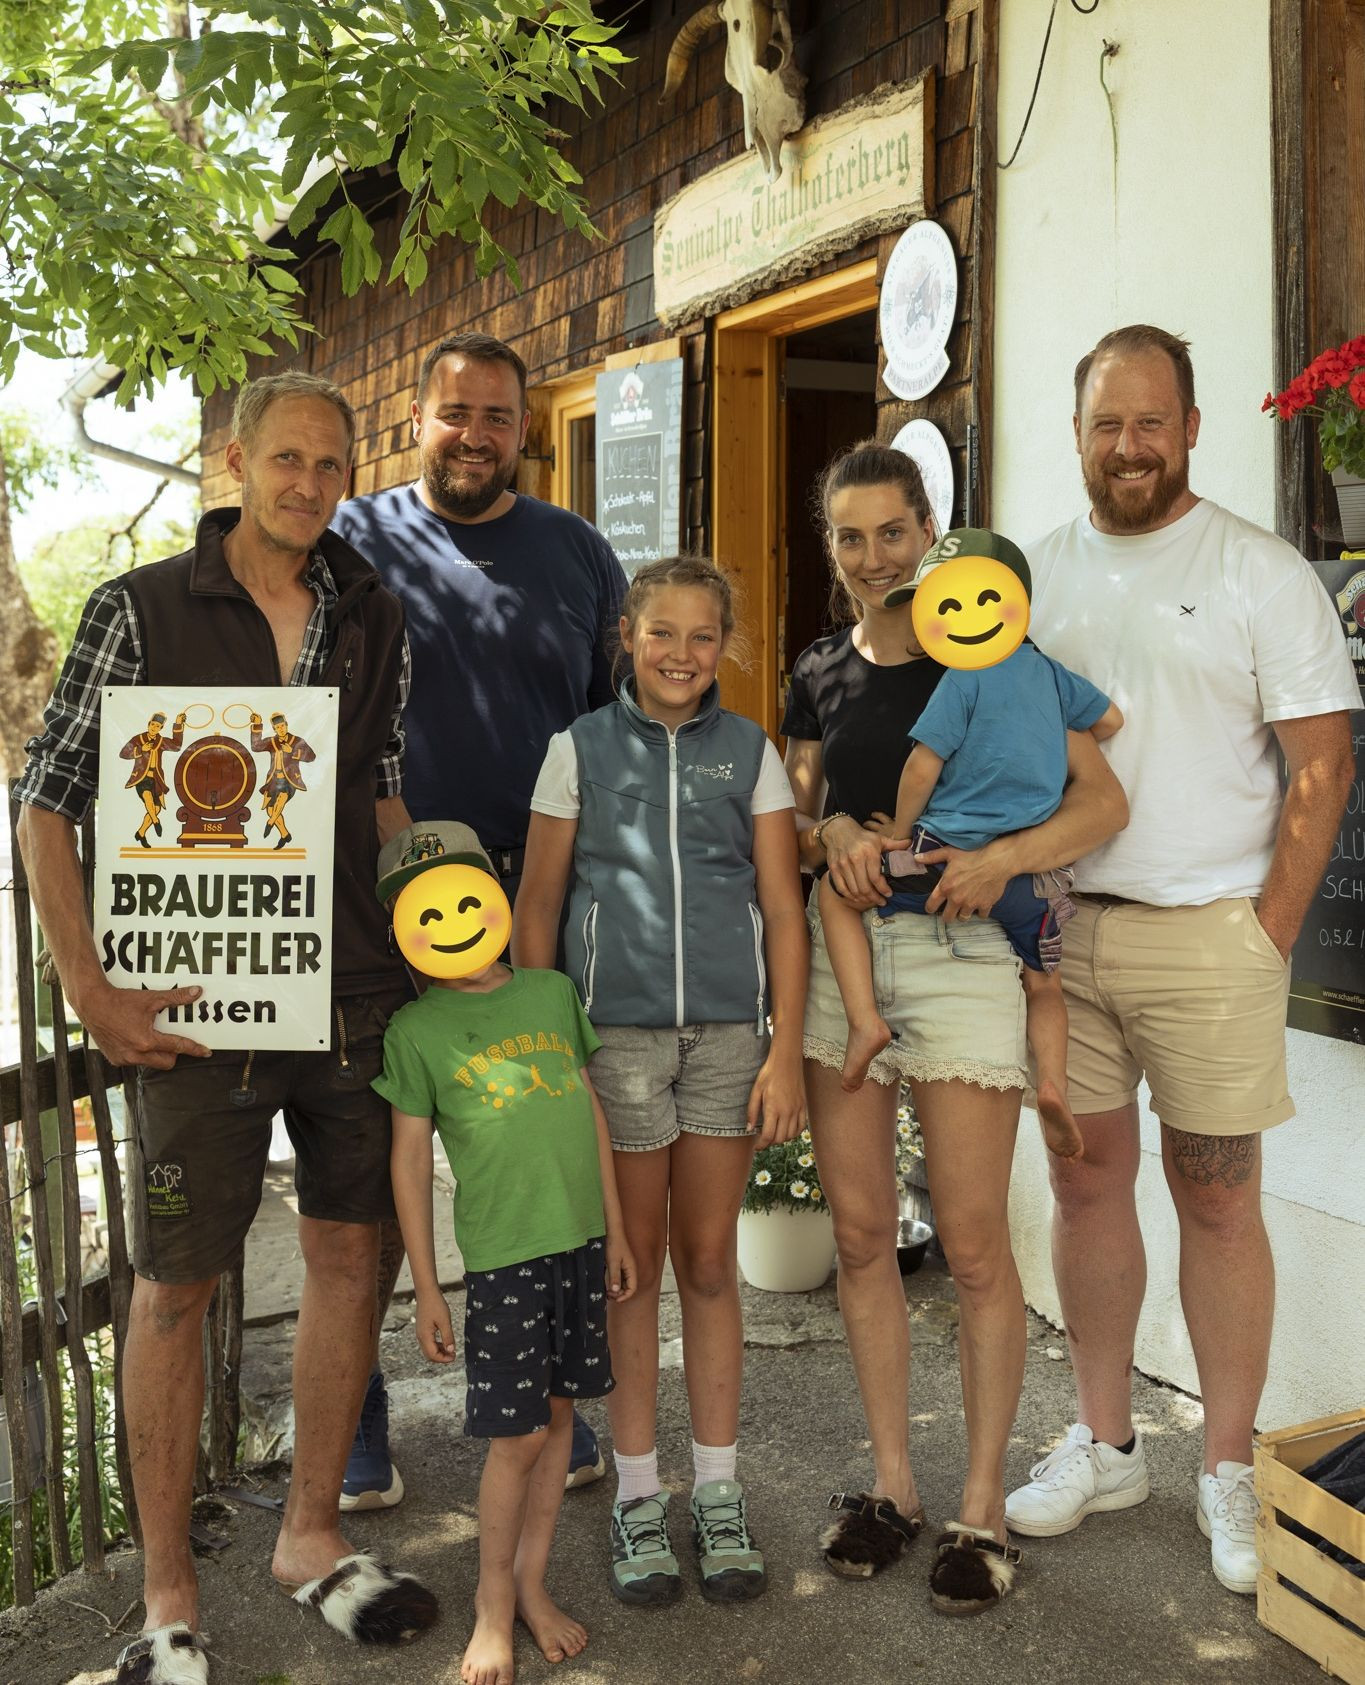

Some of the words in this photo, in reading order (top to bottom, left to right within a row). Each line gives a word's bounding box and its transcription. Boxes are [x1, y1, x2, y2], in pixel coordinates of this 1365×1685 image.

[661, 208, 743, 277] Sennalpe
[751, 130, 911, 238] Thalhoferberg
[608, 443, 657, 475] KUCHEN
[202, 822, 223, 832] 1868
[110, 873, 316, 919] BRAUEREI
[102, 929, 322, 975] SCHÄFFLER
